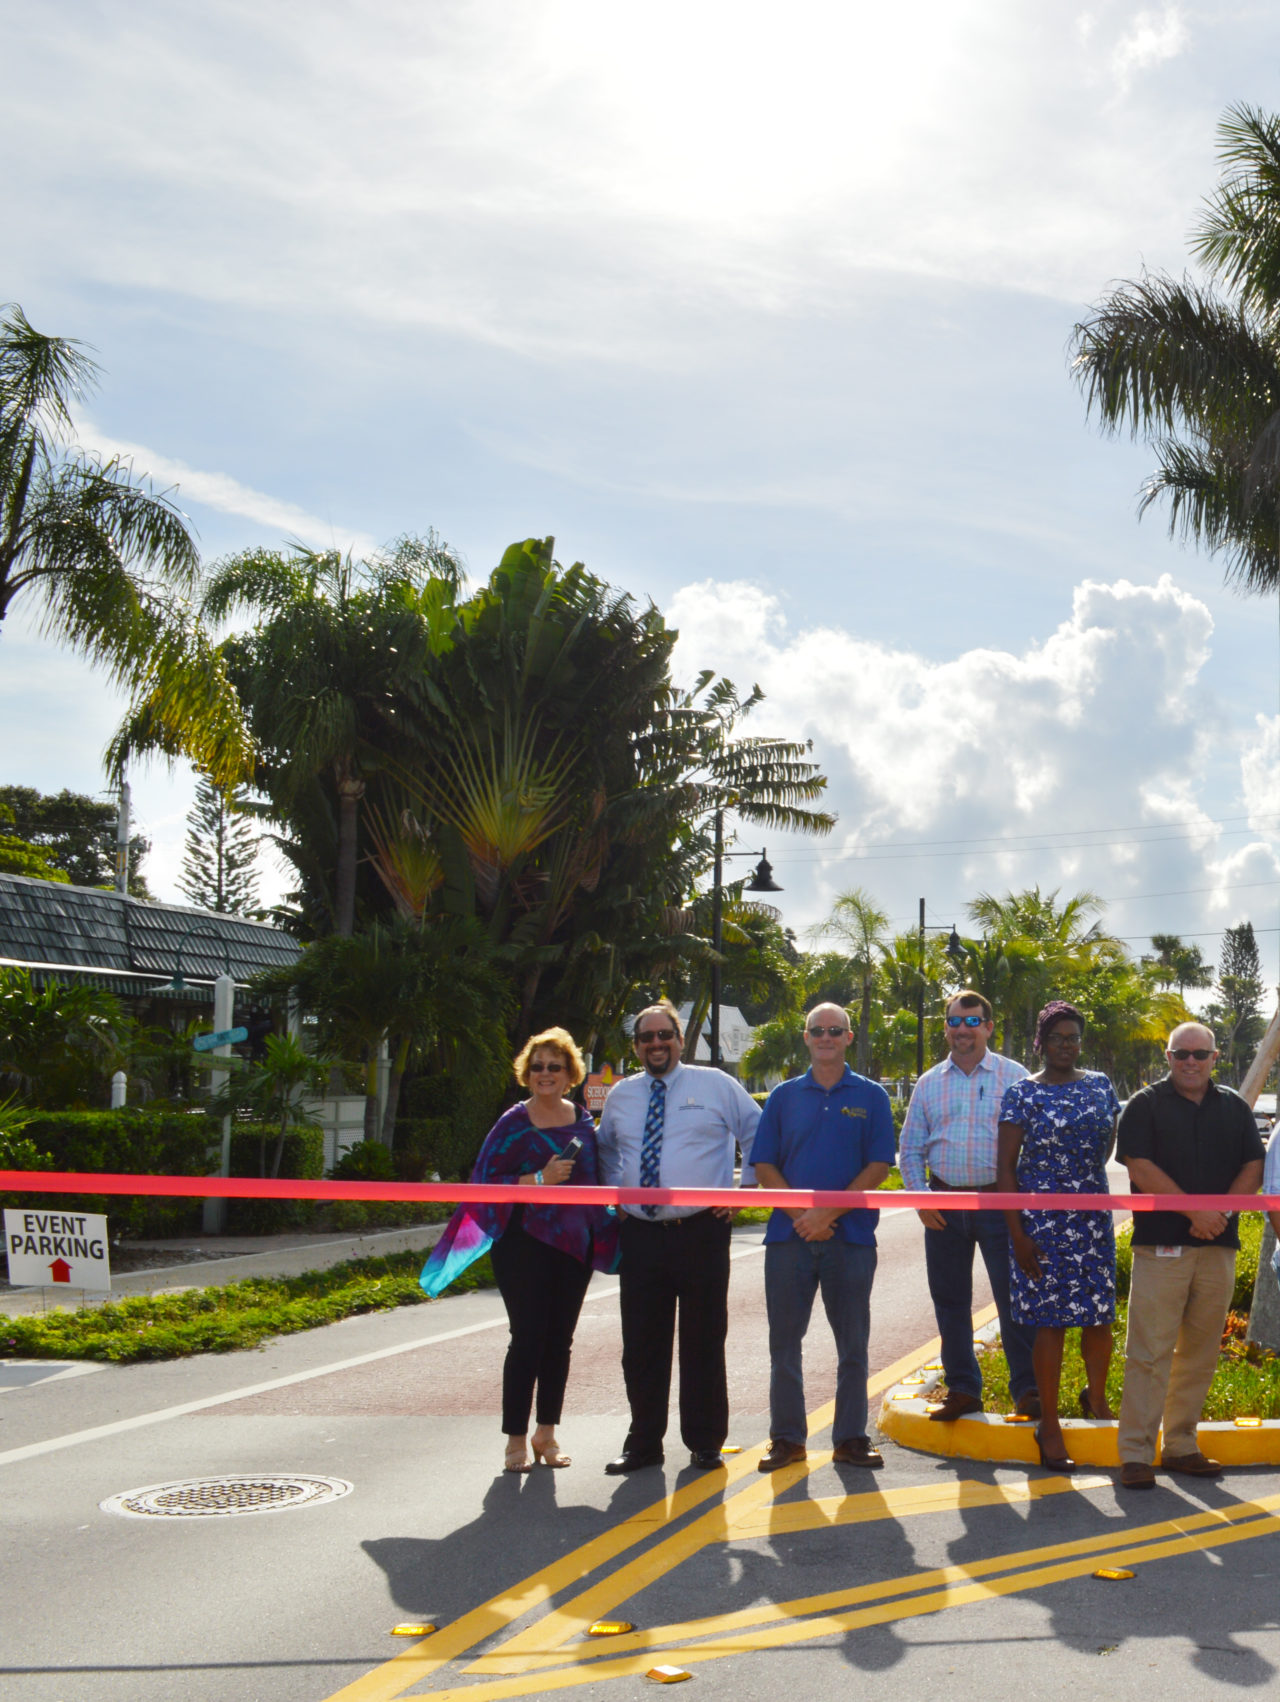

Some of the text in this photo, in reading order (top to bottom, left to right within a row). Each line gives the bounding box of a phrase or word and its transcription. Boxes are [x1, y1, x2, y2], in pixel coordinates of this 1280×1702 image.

[587, 1086, 611, 1098] SCHOO
[23, 1214, 87, 1236] EVENT
[10, 1234, 105, 1260] PARKING
